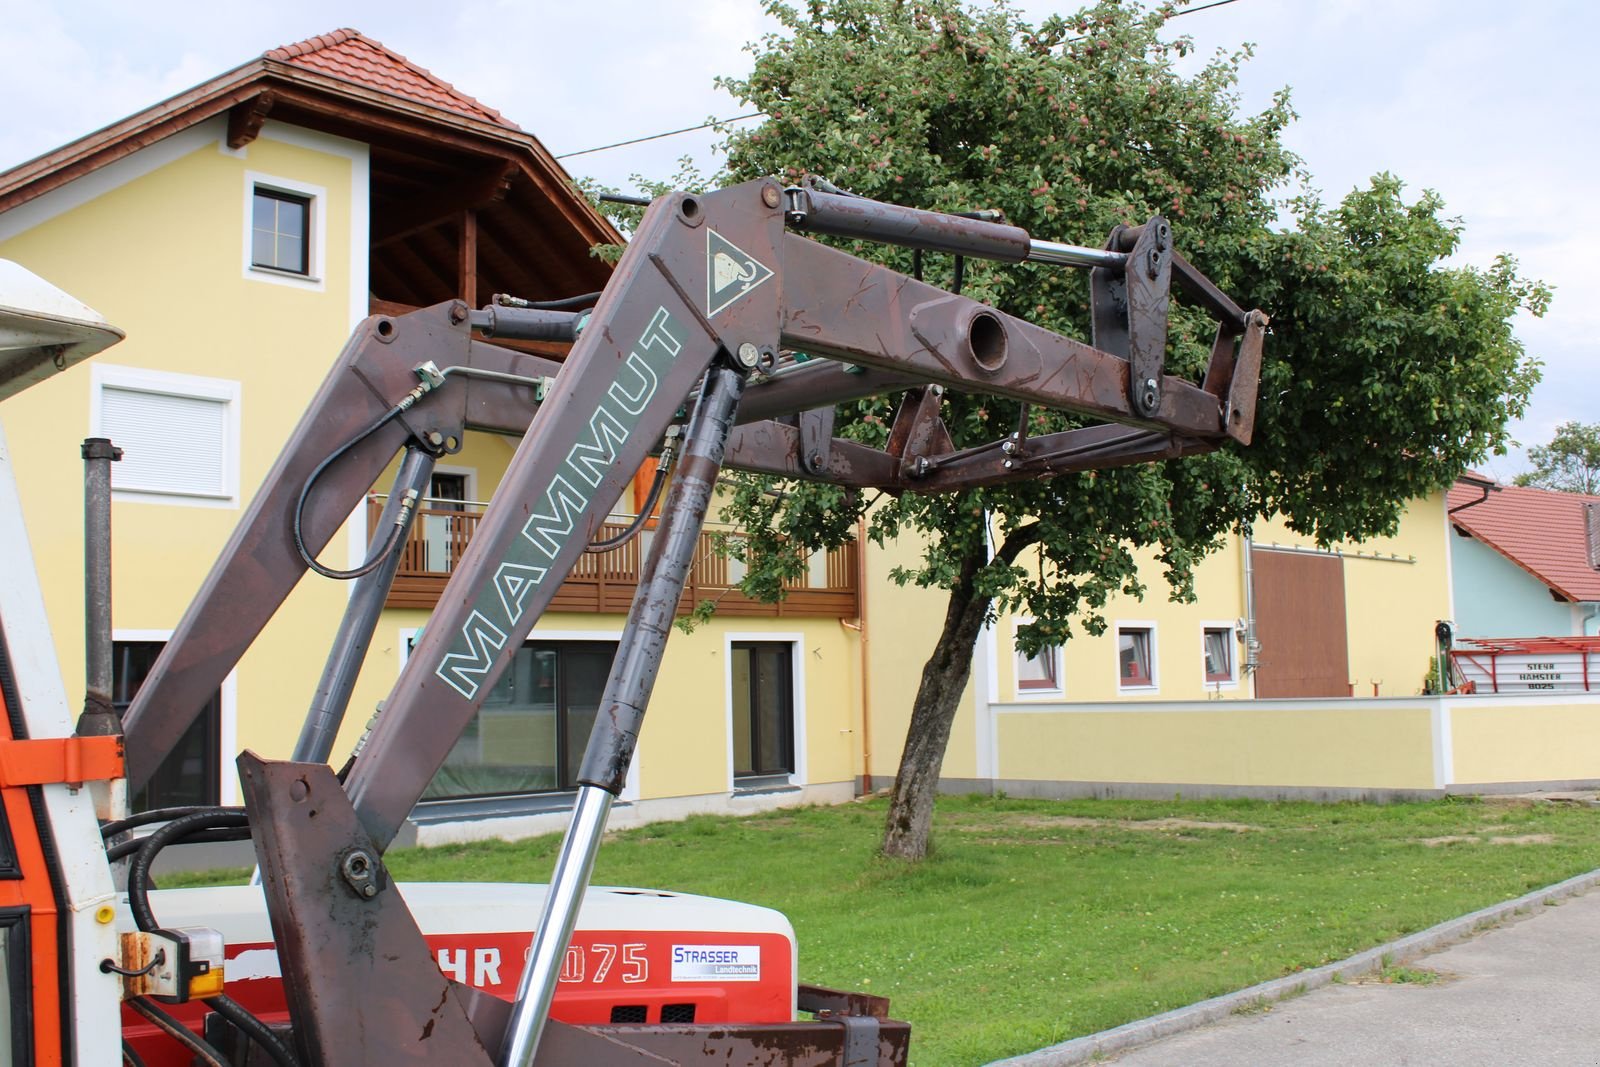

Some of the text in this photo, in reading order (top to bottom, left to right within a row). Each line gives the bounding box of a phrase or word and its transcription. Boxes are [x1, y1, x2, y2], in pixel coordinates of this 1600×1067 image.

[436, 306, 682, 700] MAMMUT
[524, 943, 649, 983] 075
[674, 947, 739, 963] STRASSER
[715, 965, 758, 974] Landtechnik
